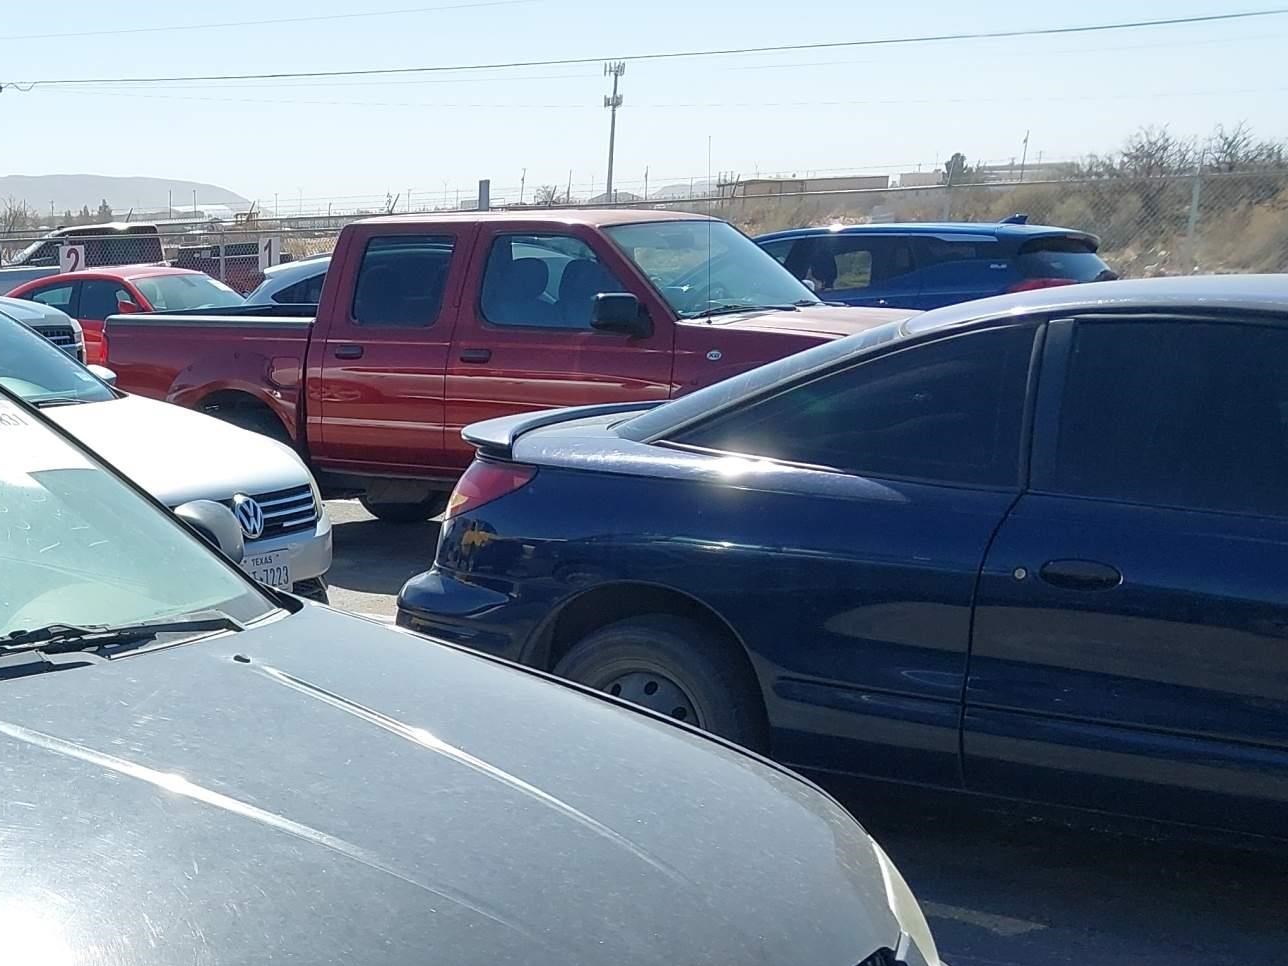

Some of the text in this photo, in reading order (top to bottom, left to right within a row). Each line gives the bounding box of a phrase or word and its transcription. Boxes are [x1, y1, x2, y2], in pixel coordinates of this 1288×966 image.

[65, 247, 81, 273] 2
[262, 238, 273, 268] 1
[251, 555, 273, 567] TEXAS
